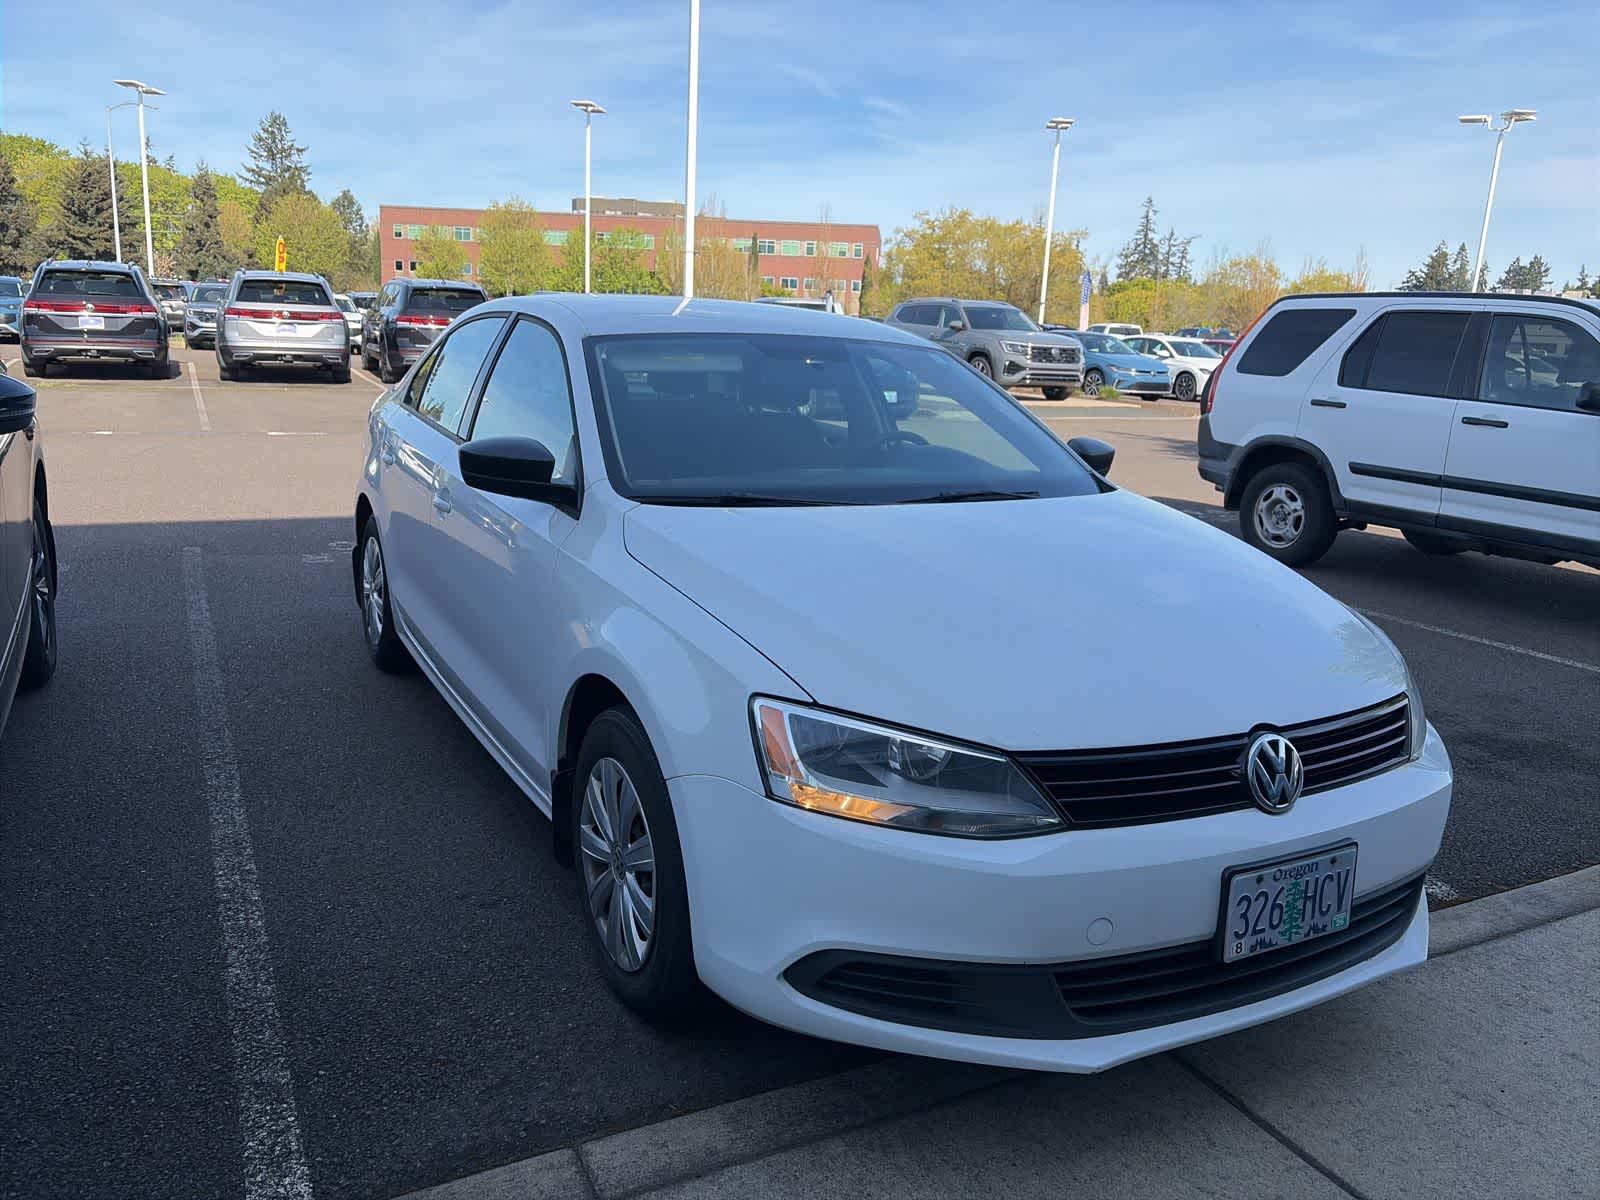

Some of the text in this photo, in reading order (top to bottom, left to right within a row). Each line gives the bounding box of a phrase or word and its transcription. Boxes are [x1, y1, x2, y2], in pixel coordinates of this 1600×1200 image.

[1250, 736, 1302, 810] VW
[1233, 868, 1350, 940] 326 HCV
[1272, 861, 1319, 882] Oregon
